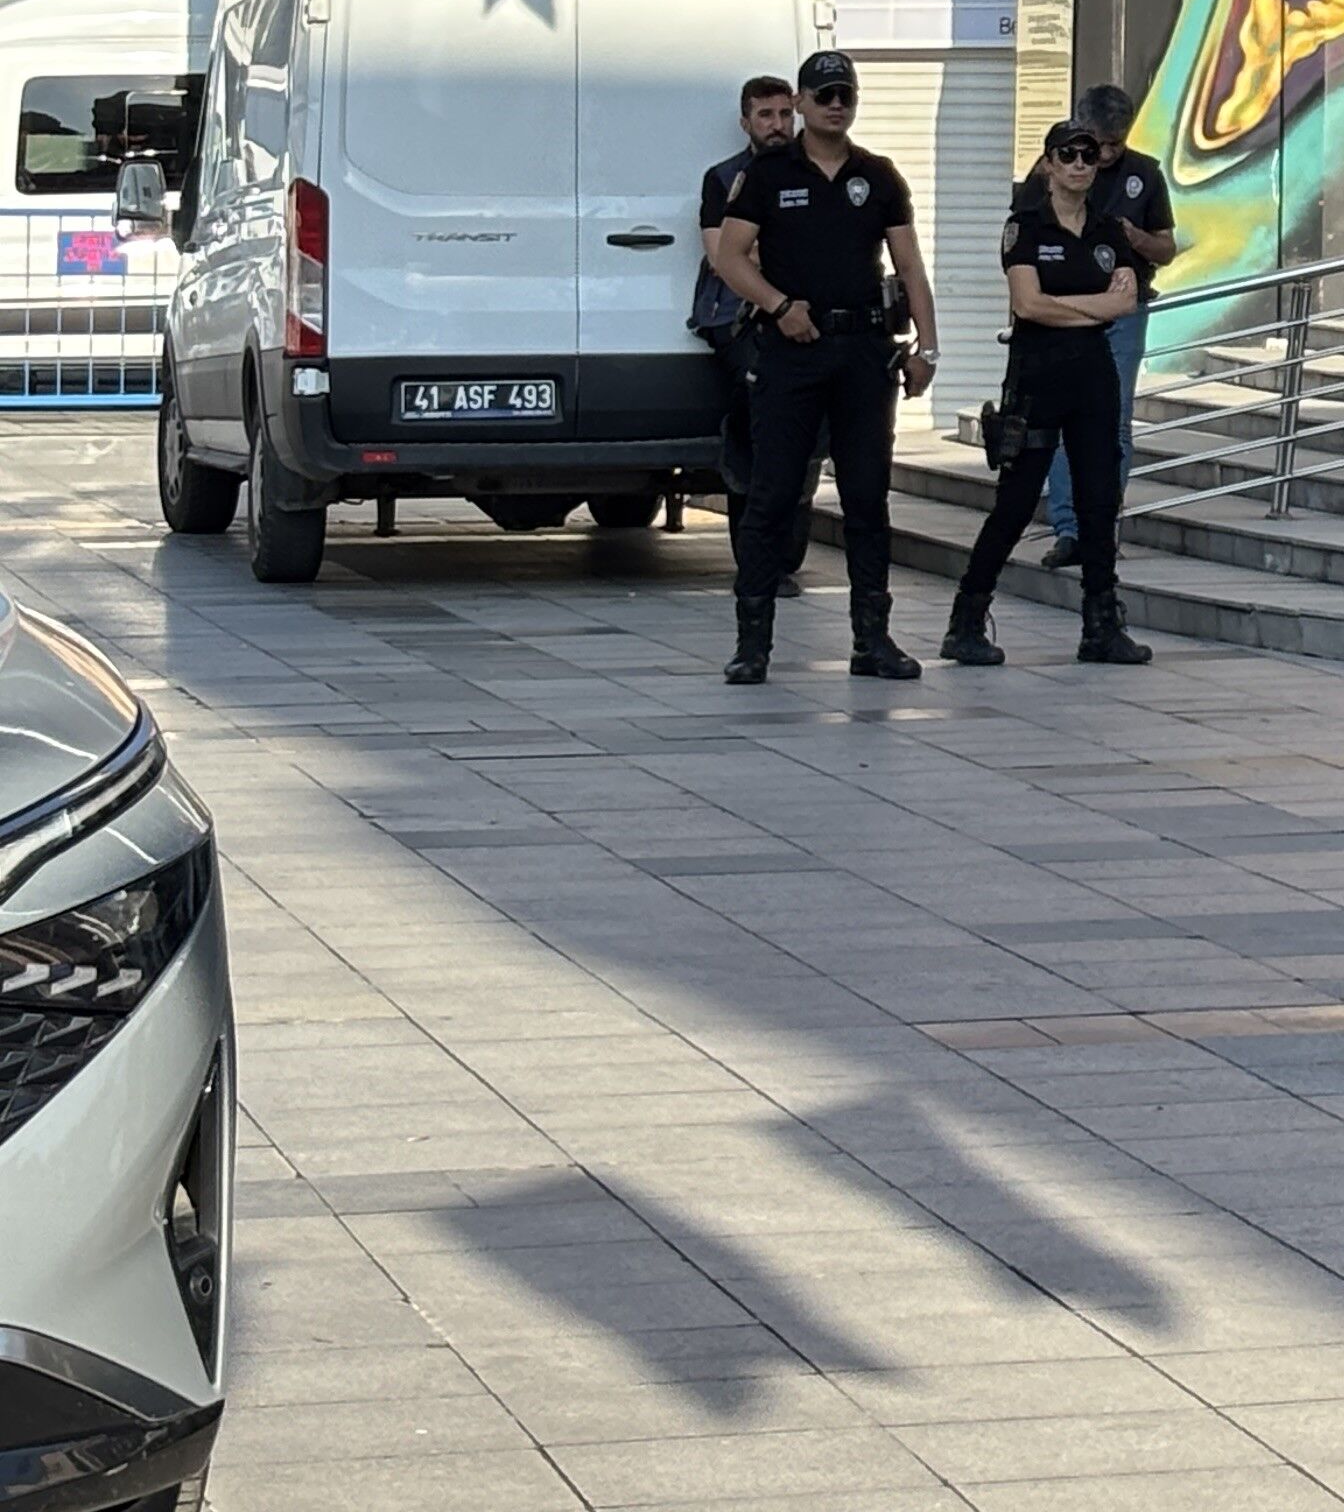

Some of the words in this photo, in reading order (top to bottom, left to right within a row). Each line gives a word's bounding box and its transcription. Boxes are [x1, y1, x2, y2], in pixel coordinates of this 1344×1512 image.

[414, 384, 440, 410] 41
[454, 384, 497, 410] ASF
[508, 384, 550, 409] 493
